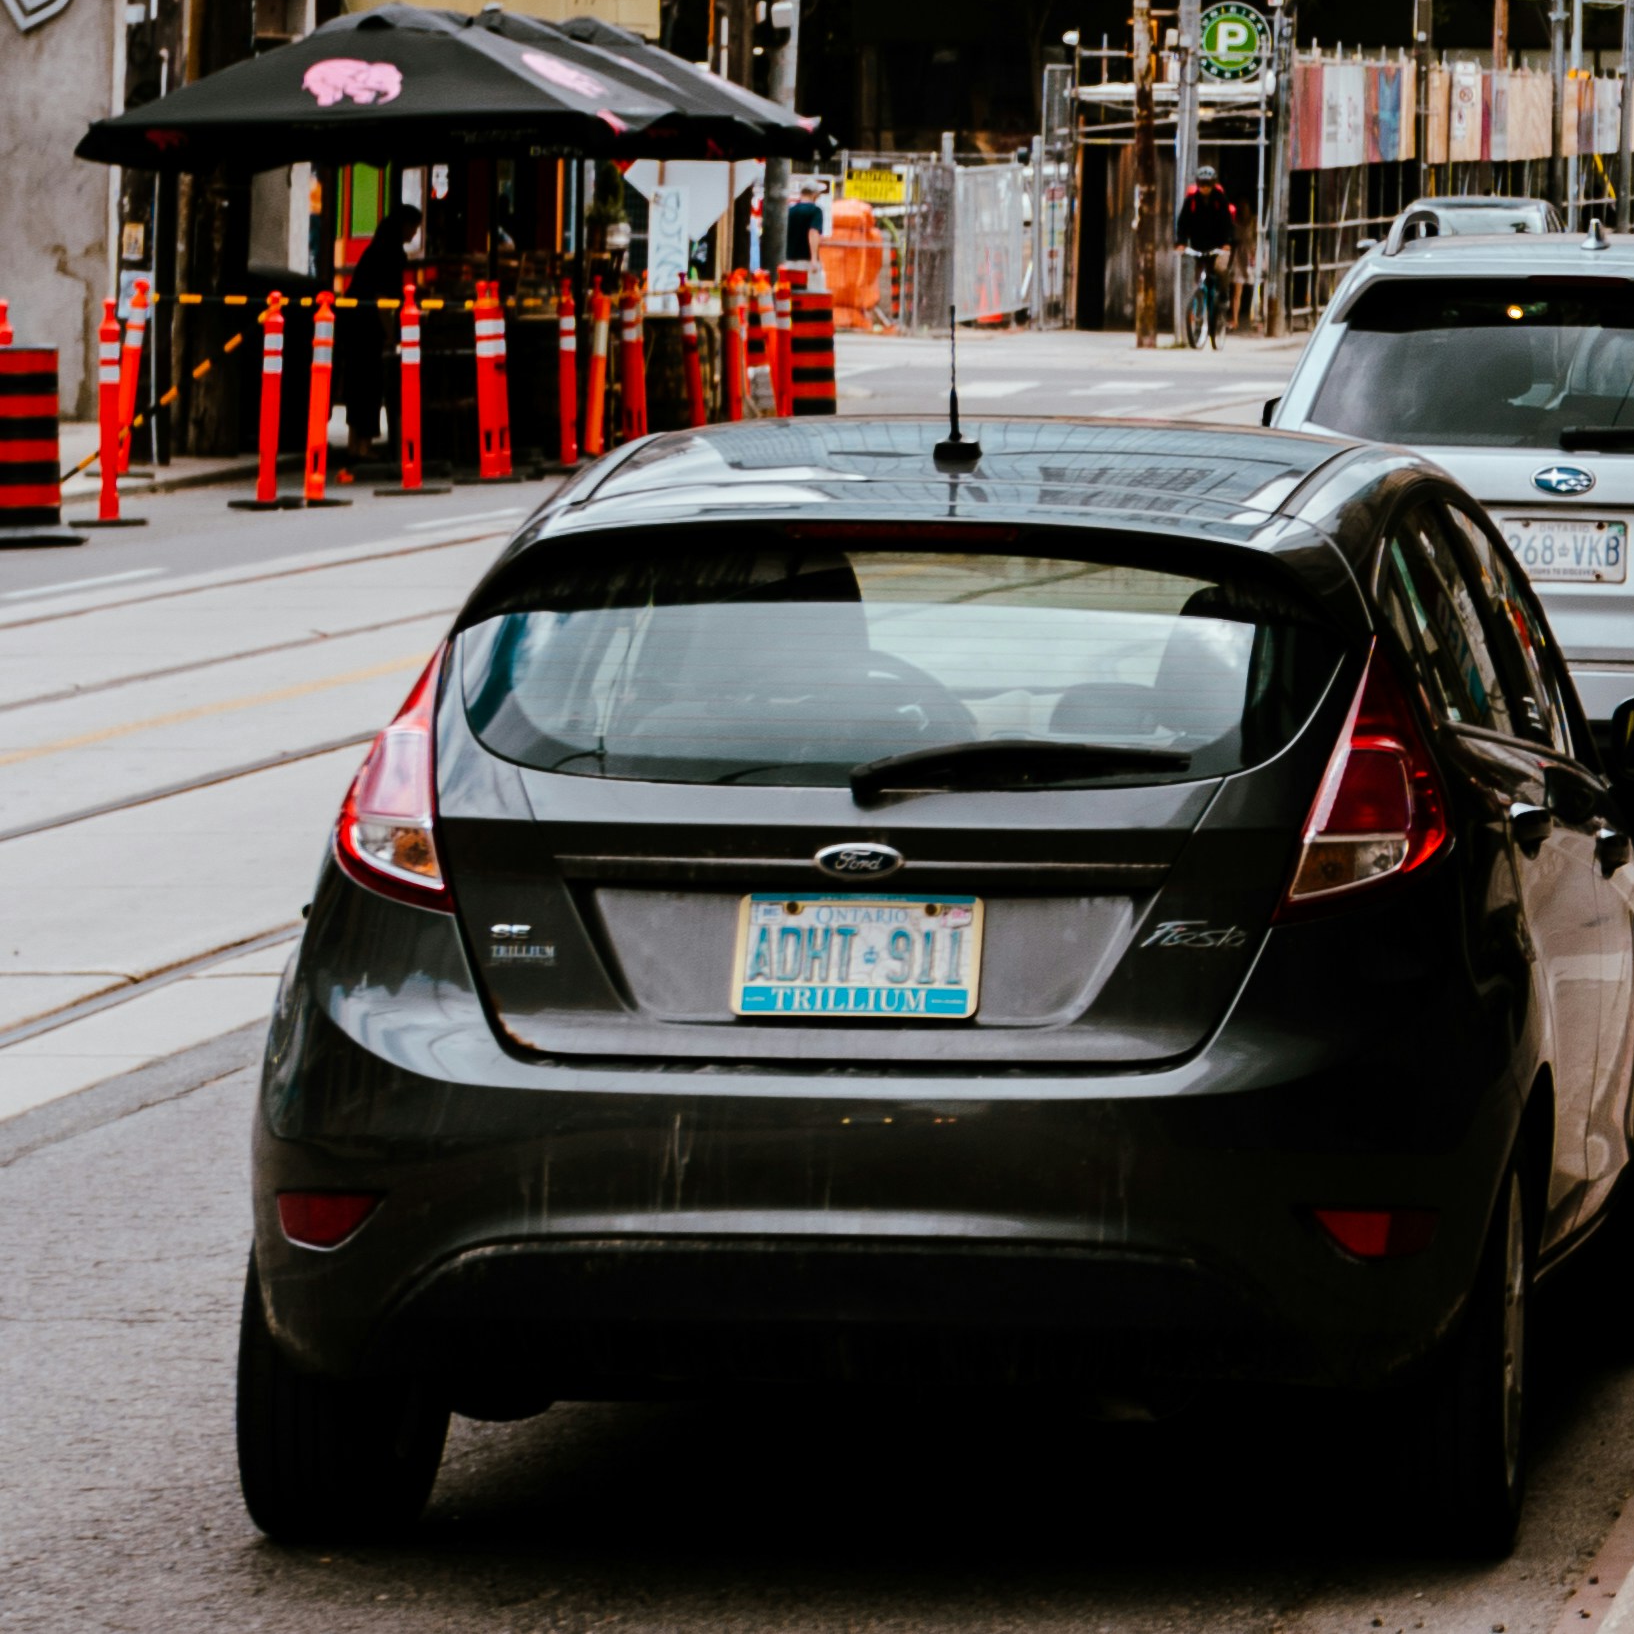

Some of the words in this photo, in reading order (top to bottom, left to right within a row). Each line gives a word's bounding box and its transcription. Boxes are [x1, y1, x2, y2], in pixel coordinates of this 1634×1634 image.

[1217, 22, 1249, 56] P
[1540, 523, 1591, 533] ONTARIO
[1572, 534, 1620, 567] VKB
[835, 850, 884, 870] Ford
[816, 907, 909, 924] ONTARIO
[749, 926, 858, 982] ADHT
[886, 928, 962, 985] 911
[770, 987, 927, 1013] TRILLIUM
